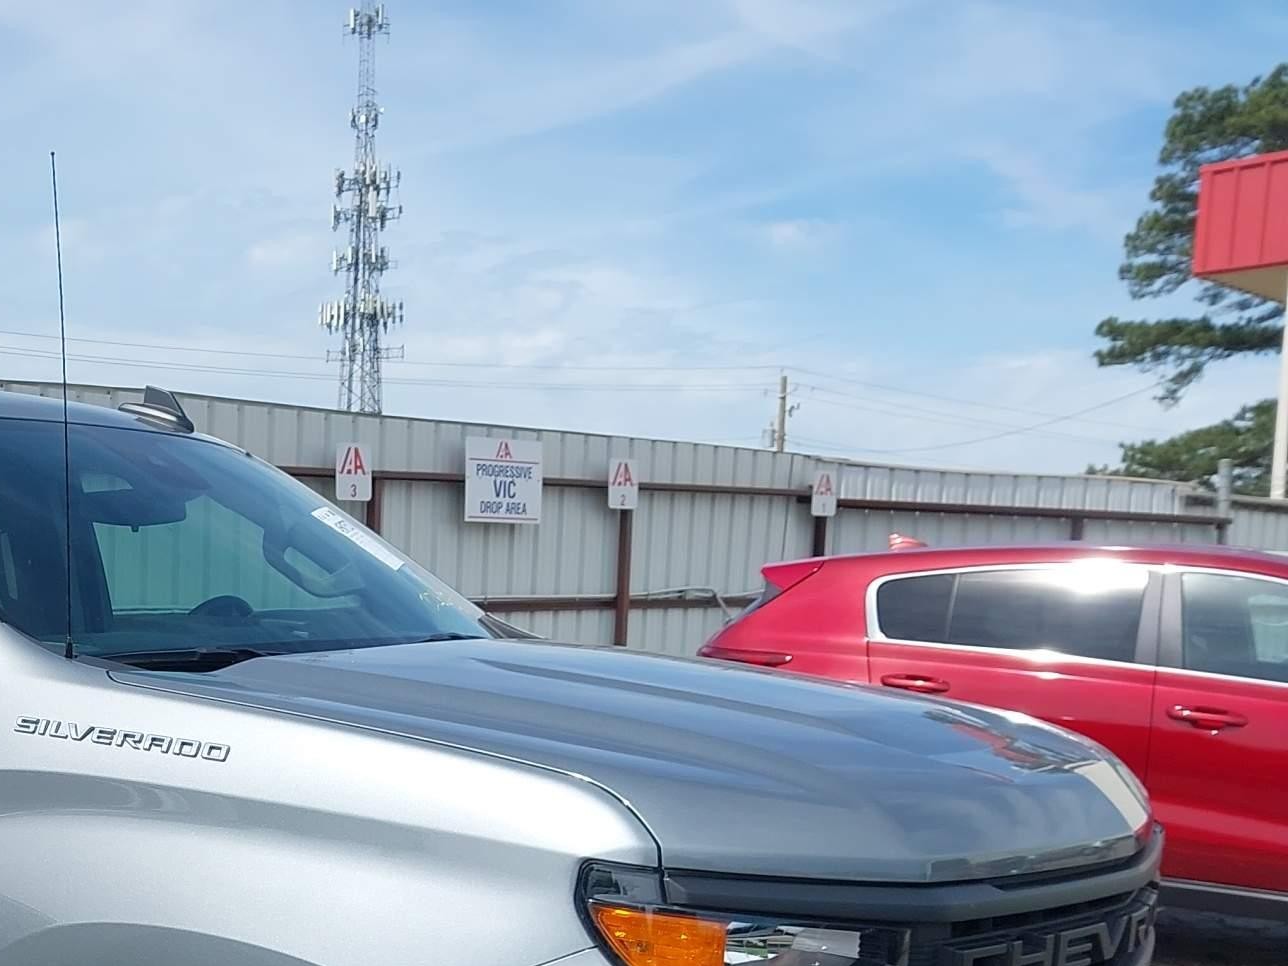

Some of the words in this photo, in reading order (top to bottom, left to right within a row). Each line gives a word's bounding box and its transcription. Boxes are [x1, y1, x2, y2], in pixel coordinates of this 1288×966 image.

[476, 463, 533, 479] PROGRESSIVE
[350, 483, 358, 498] 3
[493, 480, 516, 499] VIC
[480, 501, 503, 514] DROP
[505, 502, 528, 516] AREA
[14, 715, 231, 763] SILVERADO
